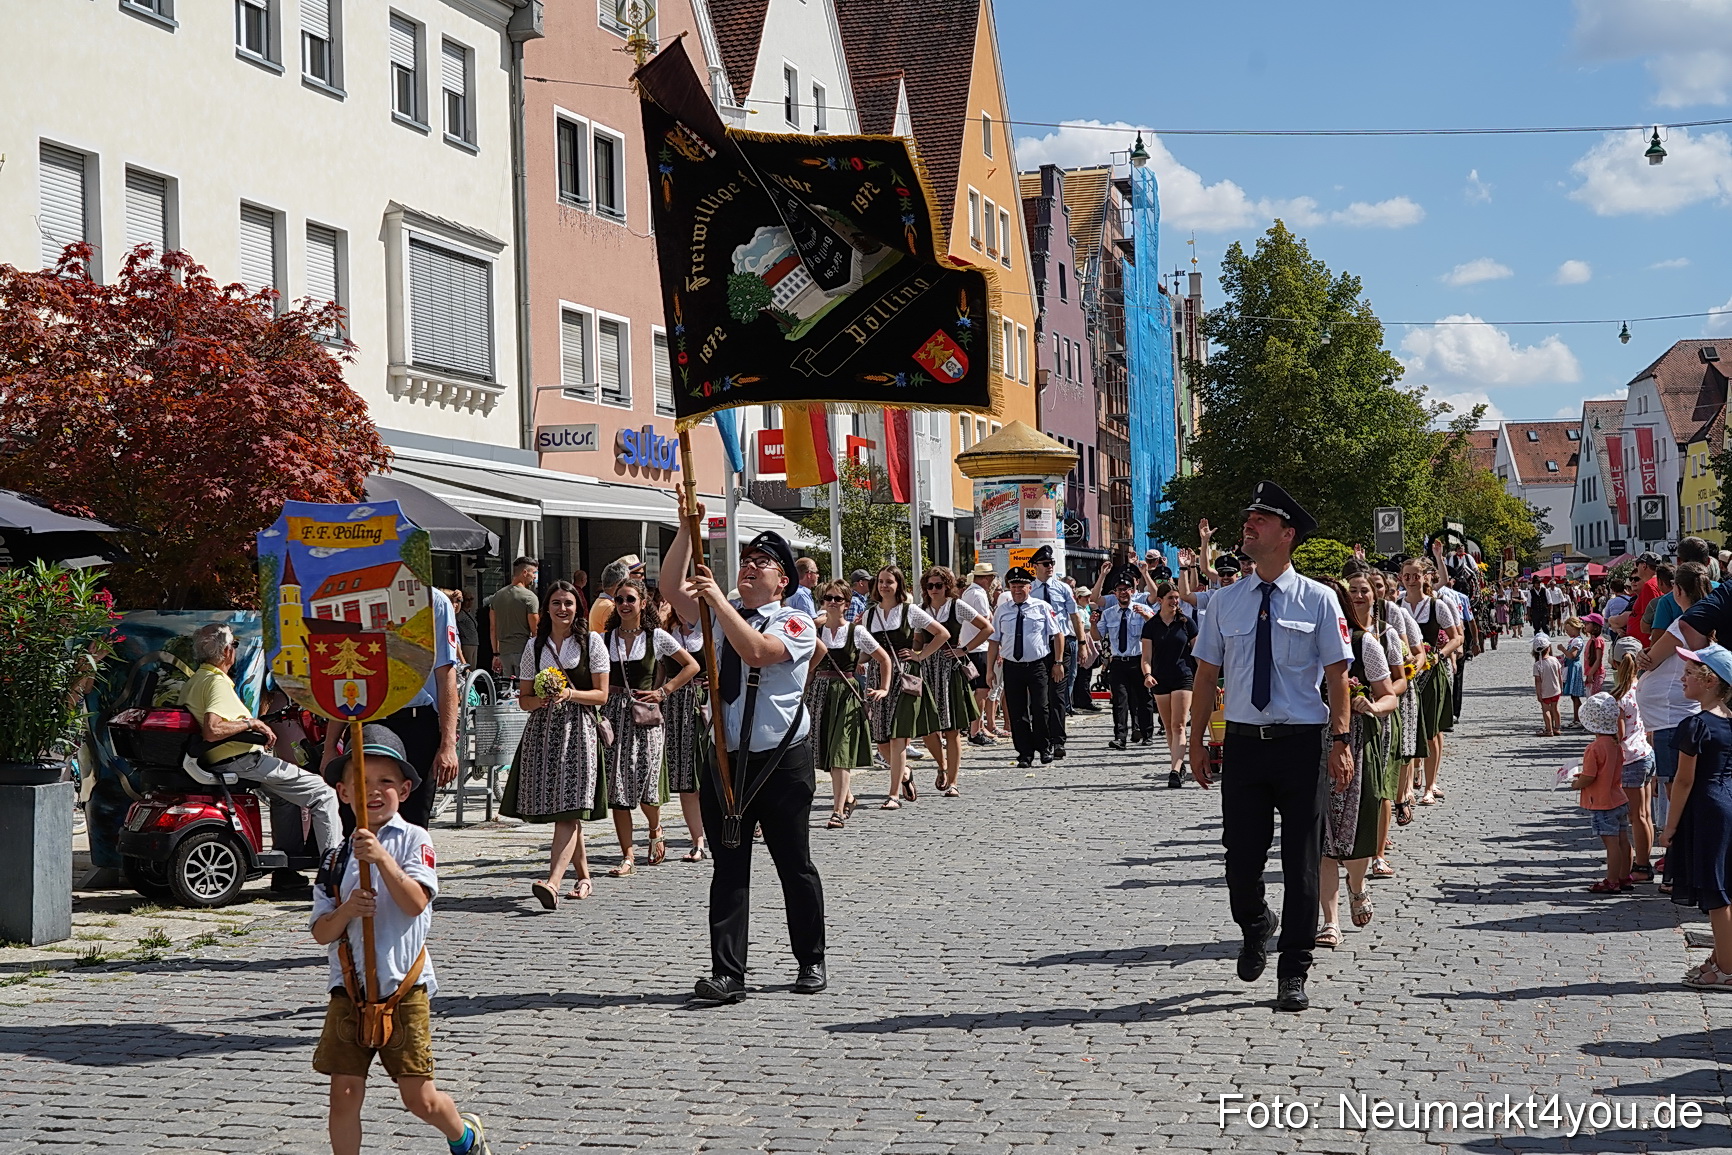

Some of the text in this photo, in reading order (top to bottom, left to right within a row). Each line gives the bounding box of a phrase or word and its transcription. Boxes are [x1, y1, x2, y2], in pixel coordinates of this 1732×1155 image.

[850, 181, 881, 215] 1972
[684, 181, 741, 293] Freiwillige
[804, 235, 833, 270] Pölling
[845, 277, 930, 345] Pölling
[698, 325, 728, 364] 1872
[539, 428, 594, 447] sutor.
[622, 424, 681, 472] sutor.
[1611, 465, 1625, 497] SALE
[333, 524, 383, 544] Pölling
